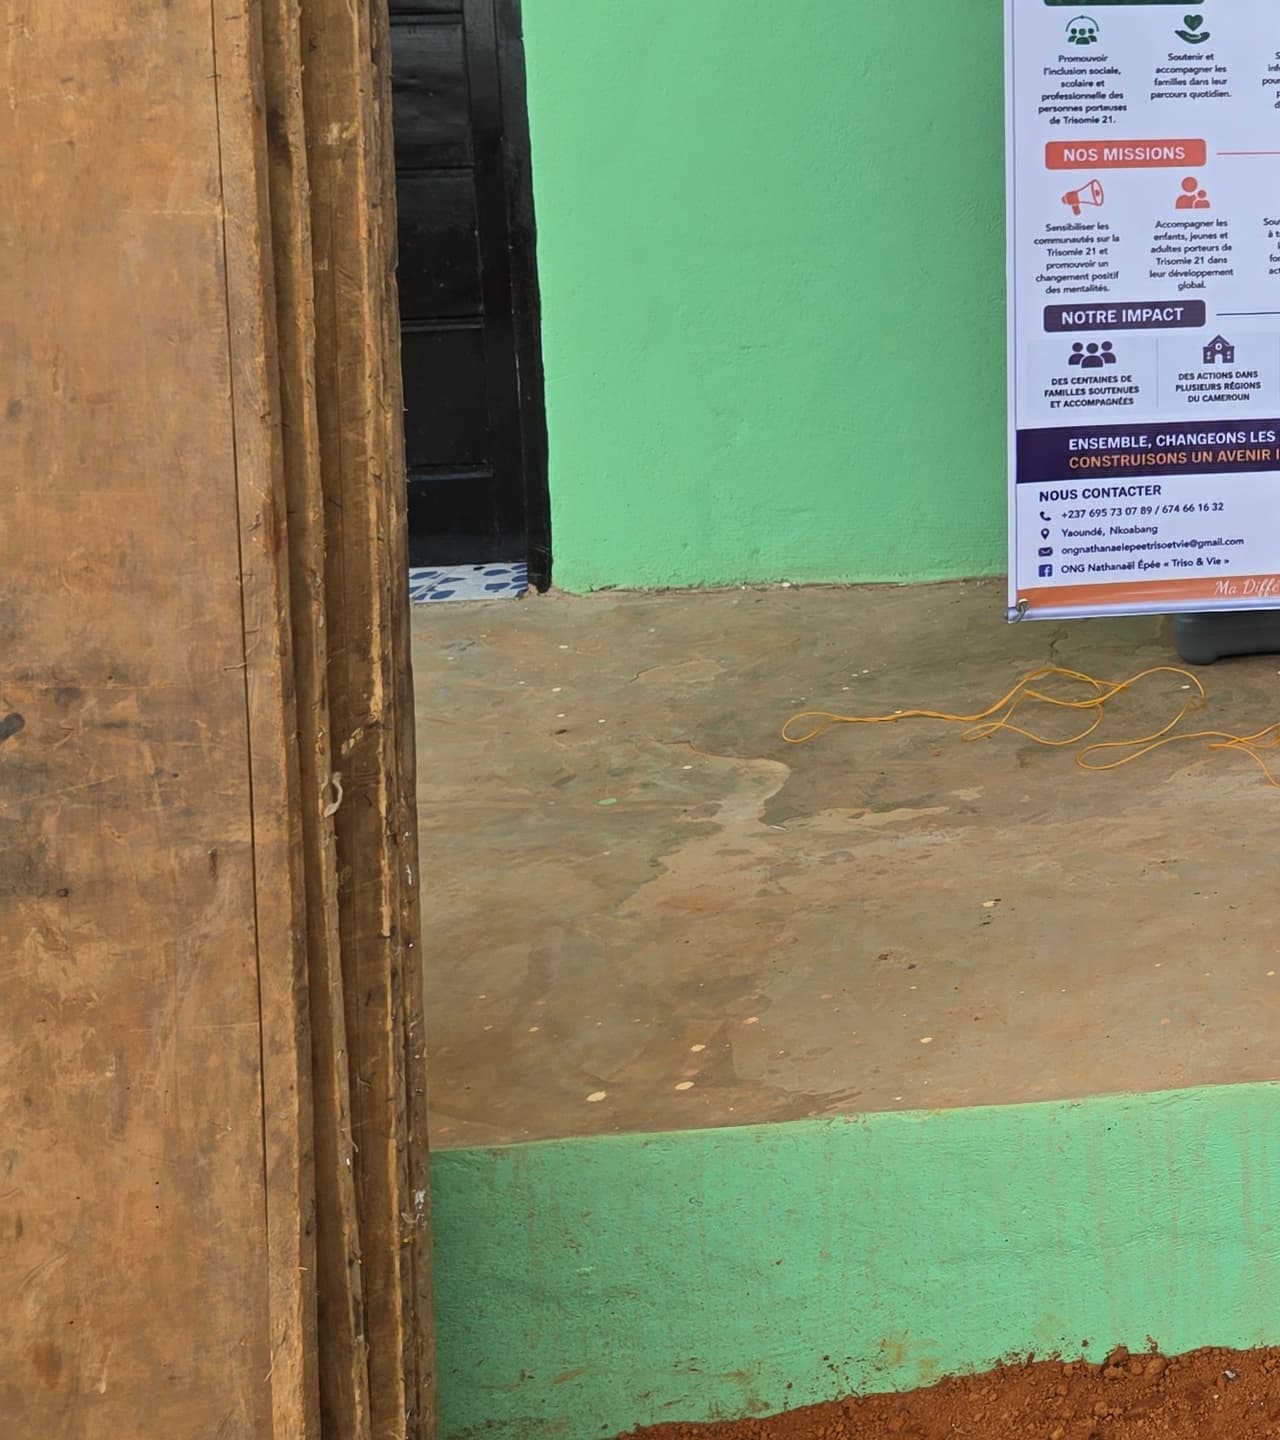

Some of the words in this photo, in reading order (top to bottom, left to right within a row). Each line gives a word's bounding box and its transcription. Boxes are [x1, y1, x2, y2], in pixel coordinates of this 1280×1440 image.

[1063, 148, 1097, 161] NOS
[1103, 146, 1185, 160] MISSIONS
[1061, 309, 1117, 324] NOTRE
[1121, 307, 1184, 322] IMPACT
[1068, 435, 1151, 450] ENSEMBLE,
[1155, 431, 1246, 446] CHANGEONS
[1250, 430, 1275, 442] LES
[1069, 451, 1187, 468] CONSTRUISONS
[1191, 450, 1212, 462] UN
[1216, 448, 1270, 461] AVENIR
[1039, 488, 1078, 502] NOUS
[1081, 484, 1161, 499] CONTACTER
[1061, 508, 1086, 518] +237
[1088, 507, 1107, 517] 695
[1109, 507, 1122, 516] 73
[1124, 506, 1137, 515] 07
[1139, 505, 1152, 515] 89
[1161, 504, 1180, 513] 674
[1182, 503, 1195, 512] 66
[1197, 502, 1209, 511] 16
[1211, 501, 1223, 511] 32
[1060, 527, 1105, 537] Yaoundé,
[1109, 524, 1158, 535] Nkoabang
[1060, 563, 1085, 573] ONG
[1087, 560, 1135, 572] Nathanaël
[1137, 558, 1161, 571] Épée
[1171, 558, 1193, 567] Triso
[1205, 556, 1221, 565] Vie
[1214, 580, 1238, 596] Ma
